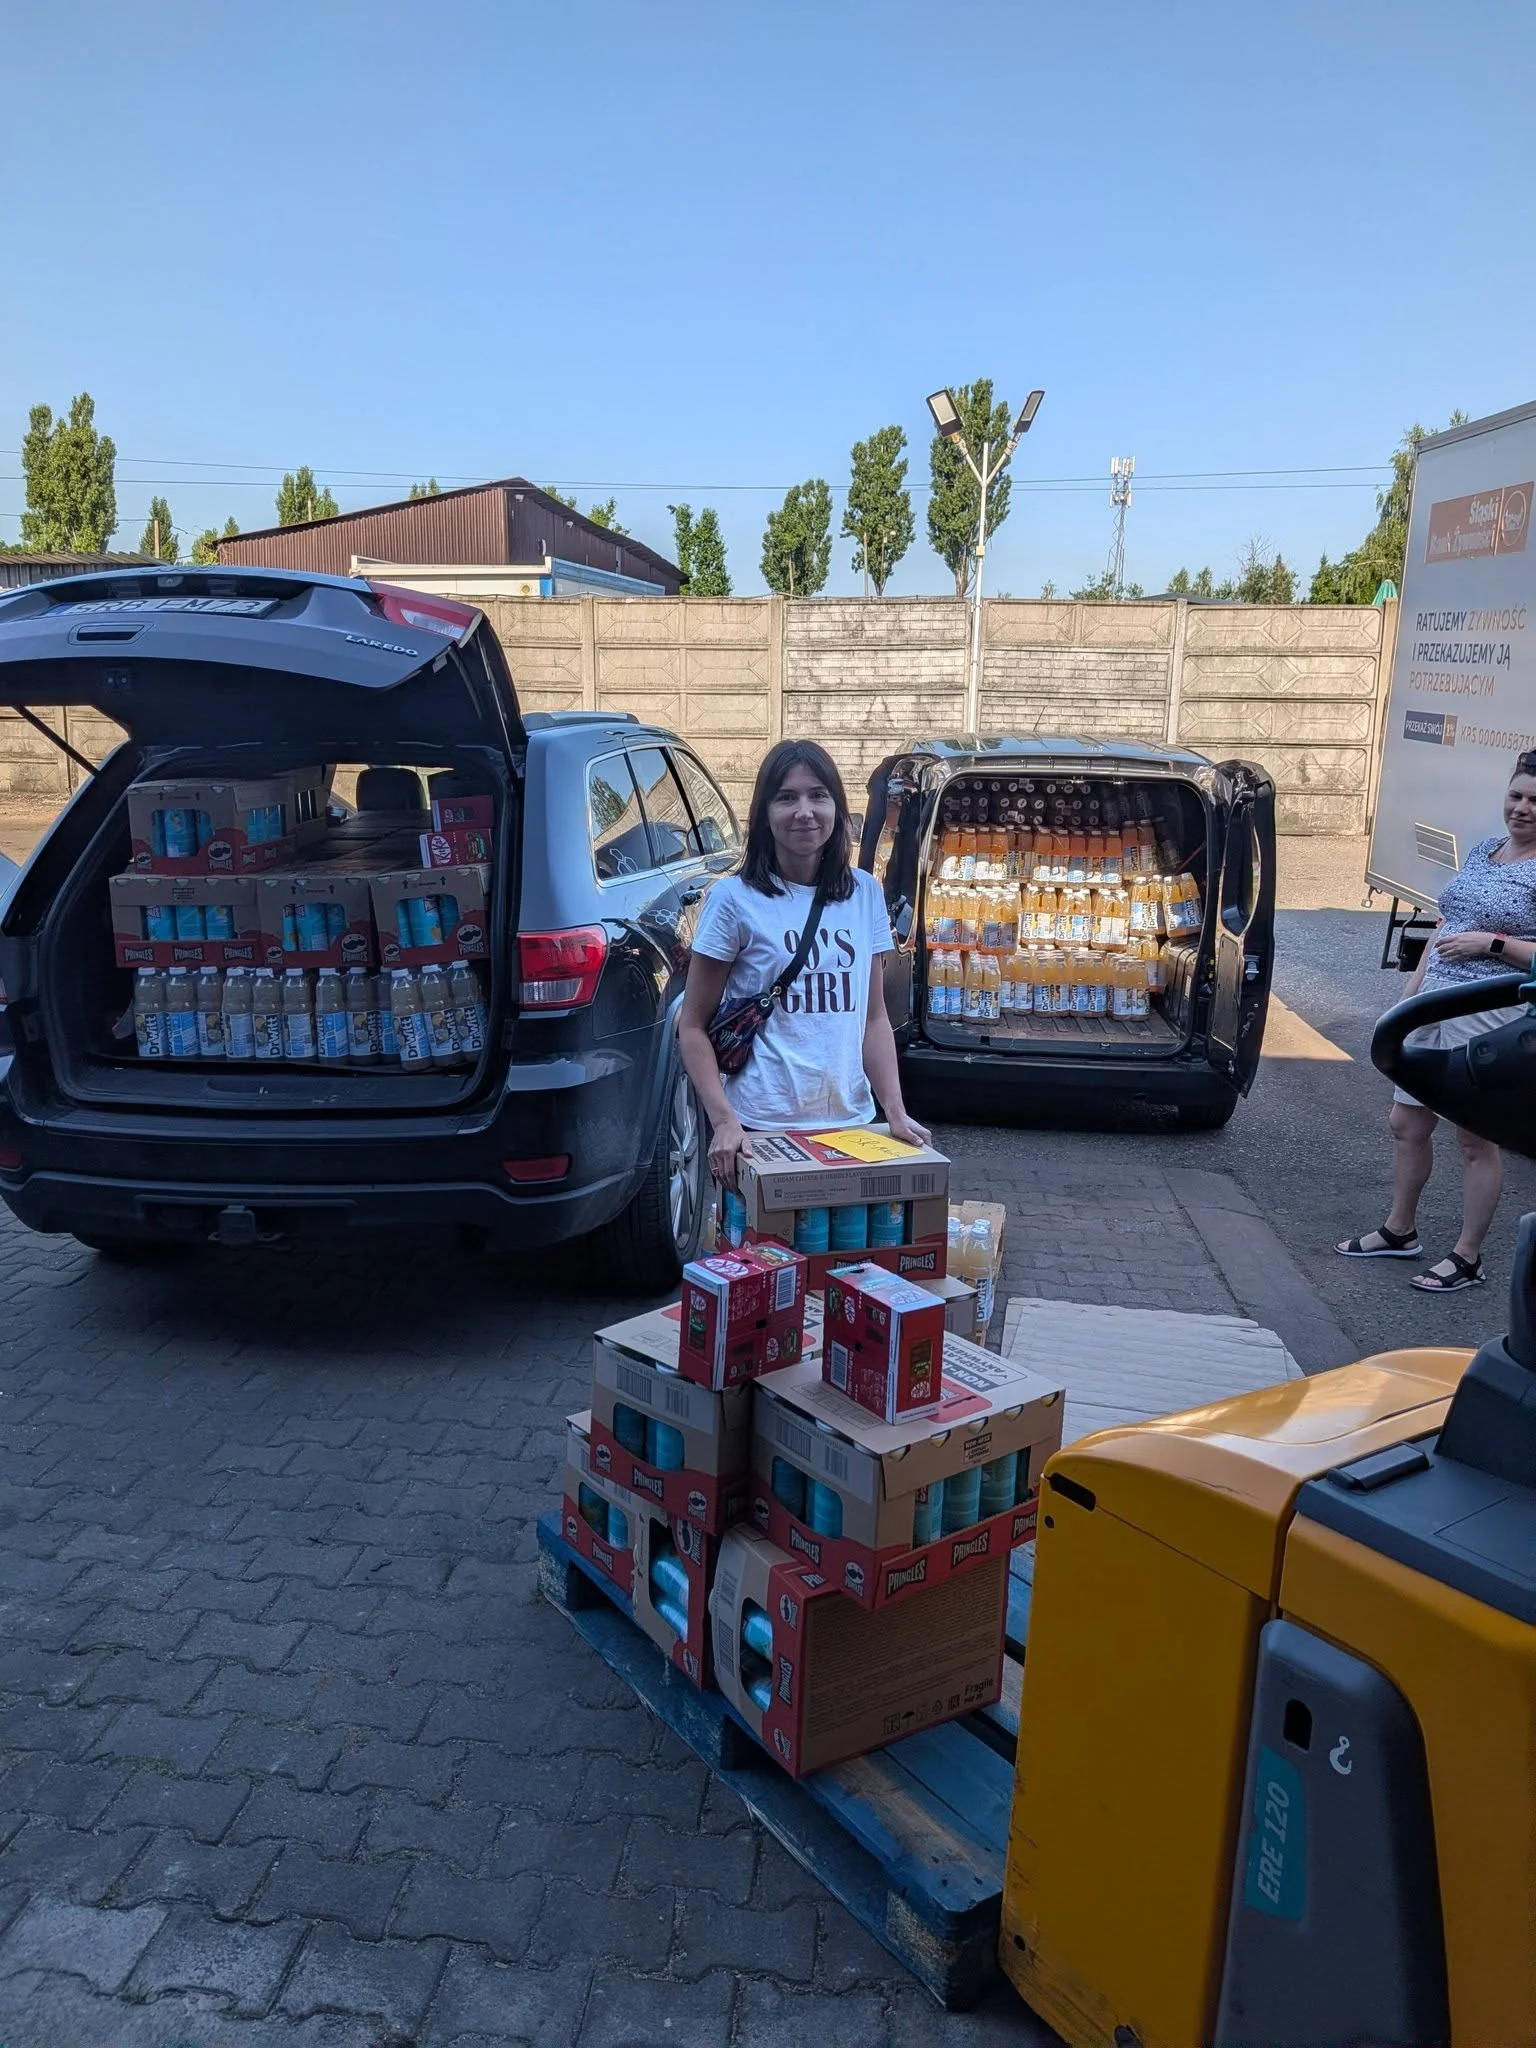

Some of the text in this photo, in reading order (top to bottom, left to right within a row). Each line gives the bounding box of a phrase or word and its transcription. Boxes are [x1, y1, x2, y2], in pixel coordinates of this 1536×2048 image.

[72, 600, 148, 613] SRB
[1416, 611, 1467, 631] RATUJEMY
[345, 634, 419, 657] LAREDO
[1412, 643, 1511, 671] I PRZEKAZUJEMY JĄ
[1409, 671, 1495, 700] POTRZEBUJĄCYM
[1186, 899, 1195, 925] DrWitt
[125, 948, 153, 961] PRINGLES
[174, 948, 203, 960] PRINGLES
[223, 947, 253, 960] PRINGLES
[780, 972, 856, 1013] GIRL
[149, 1015, 160, 1055] DrWitt
[267, 1015, 281, 1056] DrWitt
[401, 1016, 418, 1059] DrWitt
[465, 1006, 482, 1049] DrWitt
[773, 1176, 793, 1184] CREAM
[900, 1252, 936, 1271] PRINGLES
[976, 1278, 988, 1320] DrWitt
[633, 1468, 663, 1498] PRINGLES
[1013, 1513, 1038, 1538] PRINGL
[592, 1541, 613, 1571] PRINGLES
[791, 1531, 820, 1564] PRINGLES
[953, 1533, 988, 1565] PRINGLES
[887, 1560, 926, 1595] PRINGLES
[779, 1657, 792, 1705] PRINGLES
[964, 1678, 994, 1696] Fragile
[1257, 1781, 1290, 1904] ERE 120
